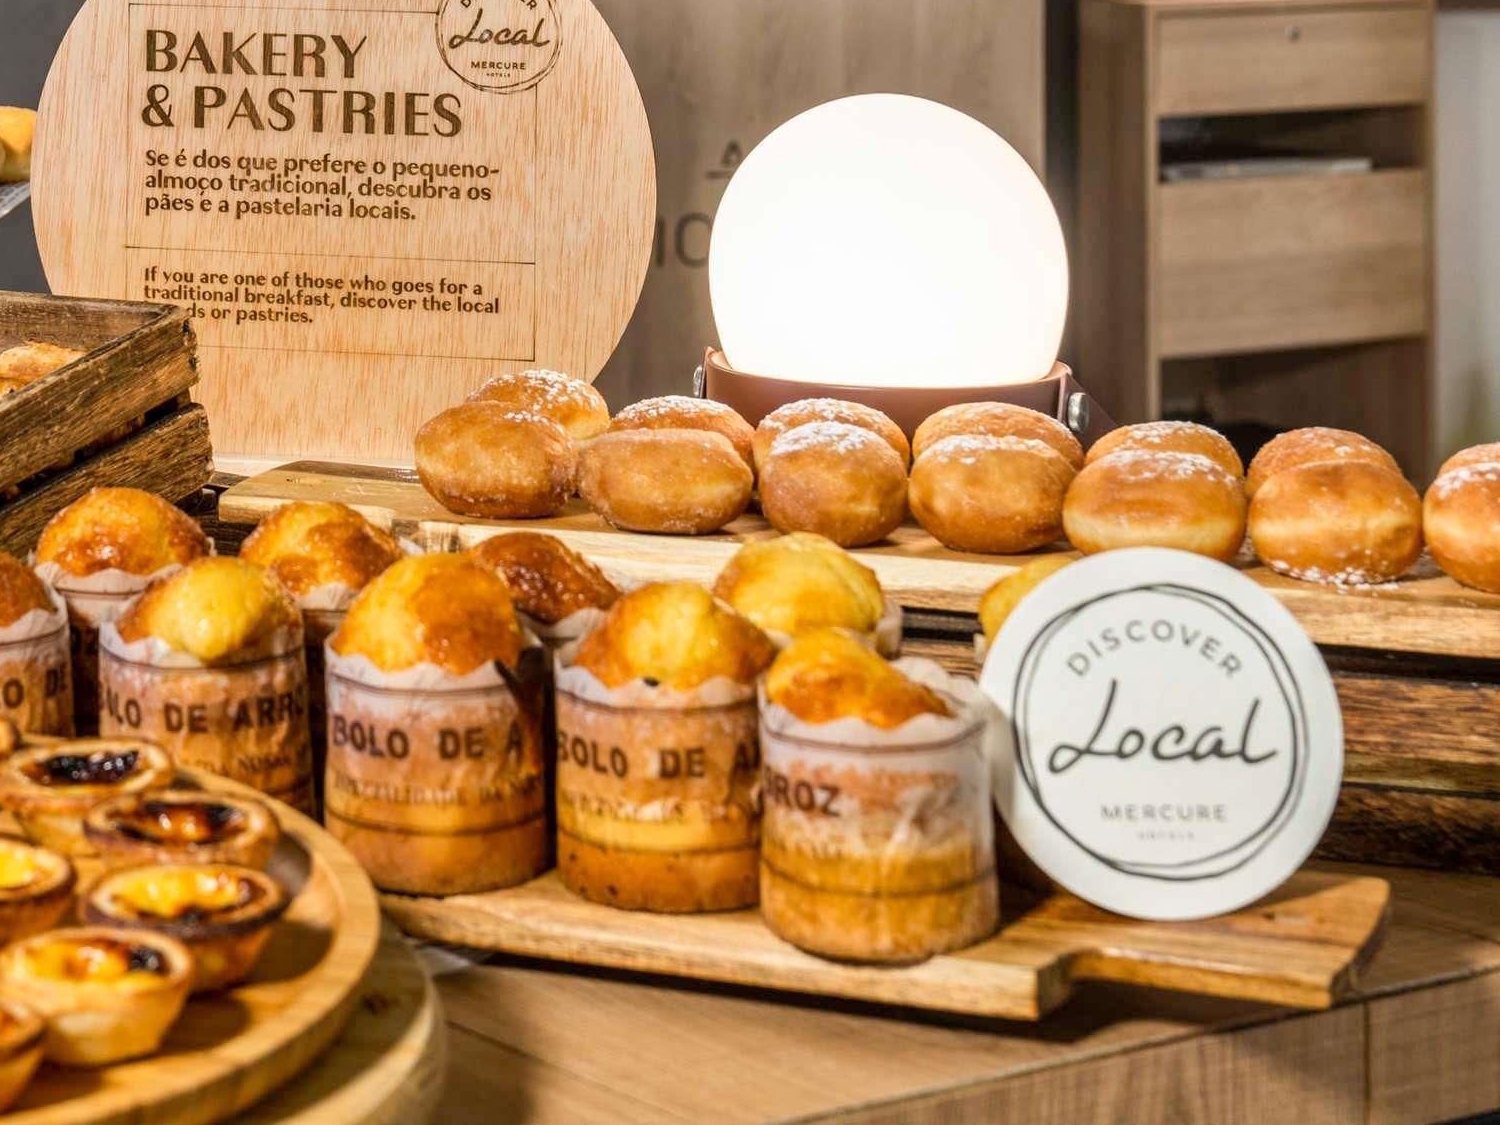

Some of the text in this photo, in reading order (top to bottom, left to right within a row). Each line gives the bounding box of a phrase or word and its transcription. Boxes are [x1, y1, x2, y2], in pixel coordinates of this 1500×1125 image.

[448, 7, 551, 49] Local
[146, 29, 367, 78] BAKERY
[470, 60, 527, 70] MERCURE
[141, 83, 461, 137] & PASTRIES
[145, 148, 500, 183] Se é dos que prefere o pequeno-
[145, 169, 492, 201] almoço tradicional, descubra os
[145, 193, 194, 216] pães
[218, 200, 229, 213] a
[236, 196, 342, 220] pastelaria
[349, 198, 416, 220] locais.
[145, 266, 483, 296] If you are one of those who goes for a
[144, 284, 500, 314] traditional breakfast, discover the local
[211, 307, 231, 319] or
[236, 307, 313, 325] pastries.
[1065, 619, 1243, 678] DISCOVER
[164, 702, 208, 733] DE
[1047, 678, 1279, 774] Local
[331, 714, 410, 759] BOLO
[439, 727, 485, 760] DE
[558, 730, 628, 778] BOLO
[659, 748, 705, 779] DE
[1099, 803, 1229, 822] MERCURE
